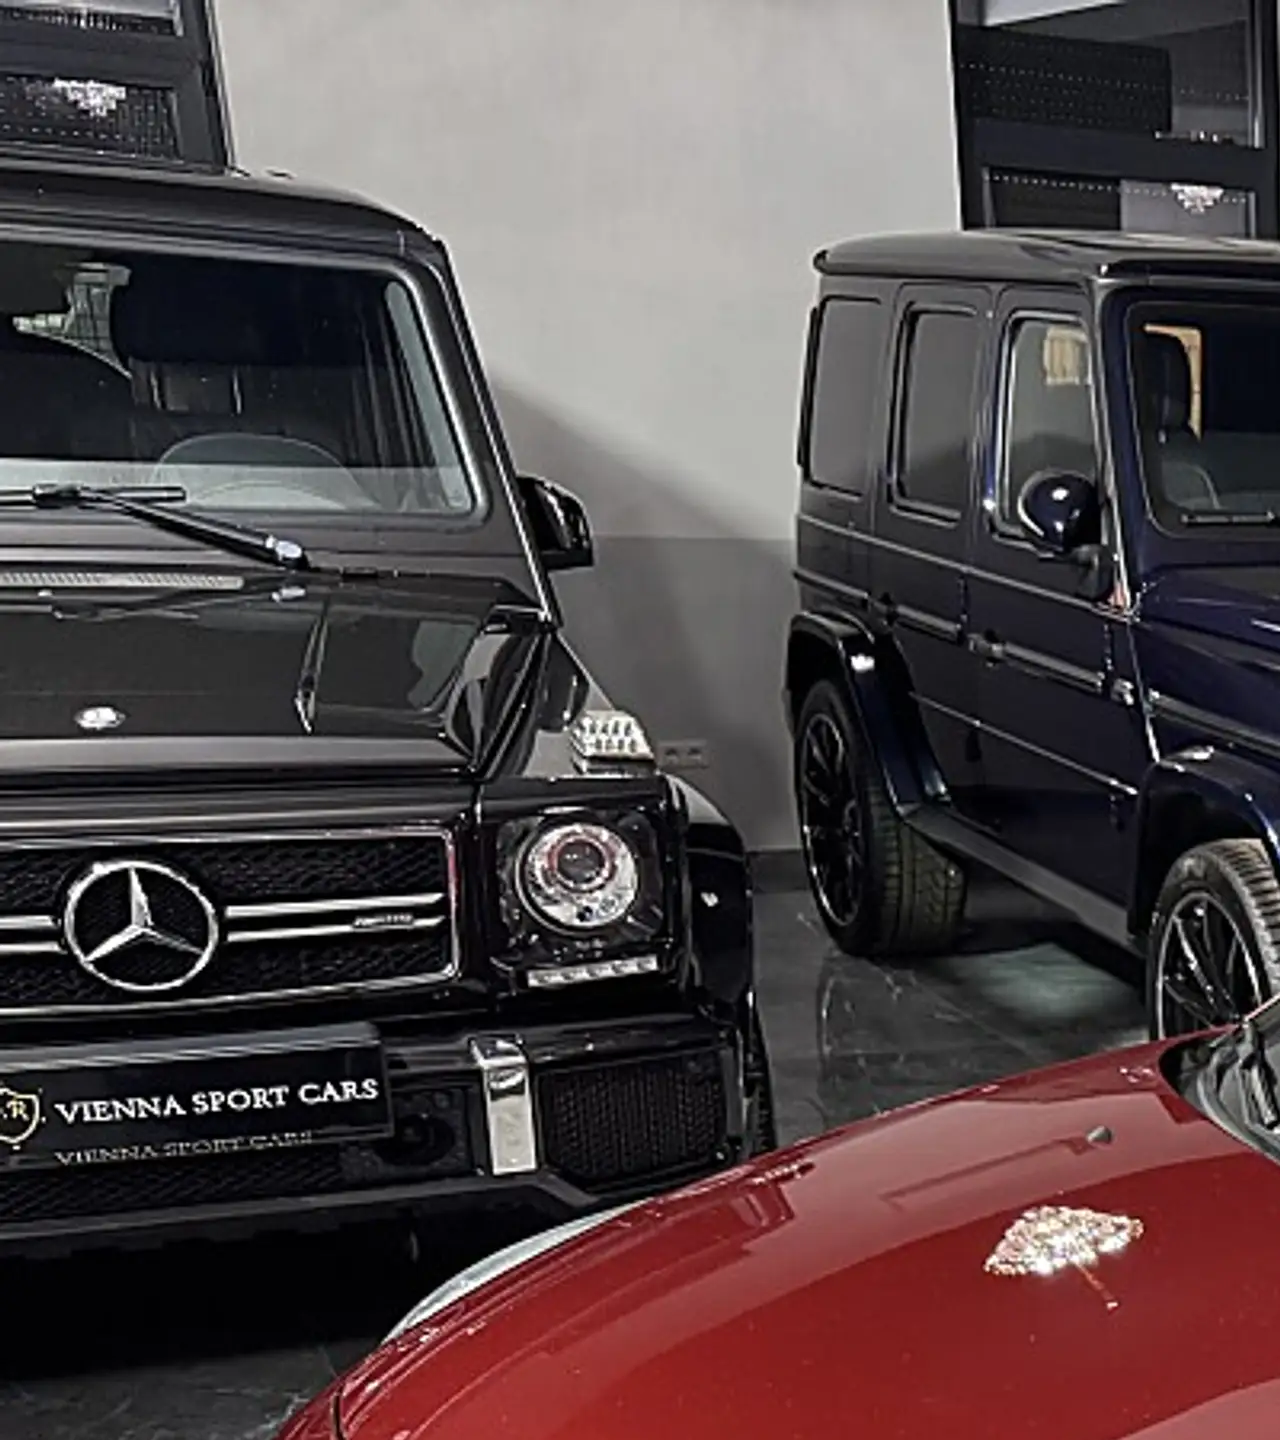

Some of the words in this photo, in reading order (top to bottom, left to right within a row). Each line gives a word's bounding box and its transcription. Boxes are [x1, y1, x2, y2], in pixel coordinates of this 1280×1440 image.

[54, 1095, 187, 1125] VIENNA
[191, 1084, 290, 1115] SPORT
[298, 1078, 380, 1105] CARS
